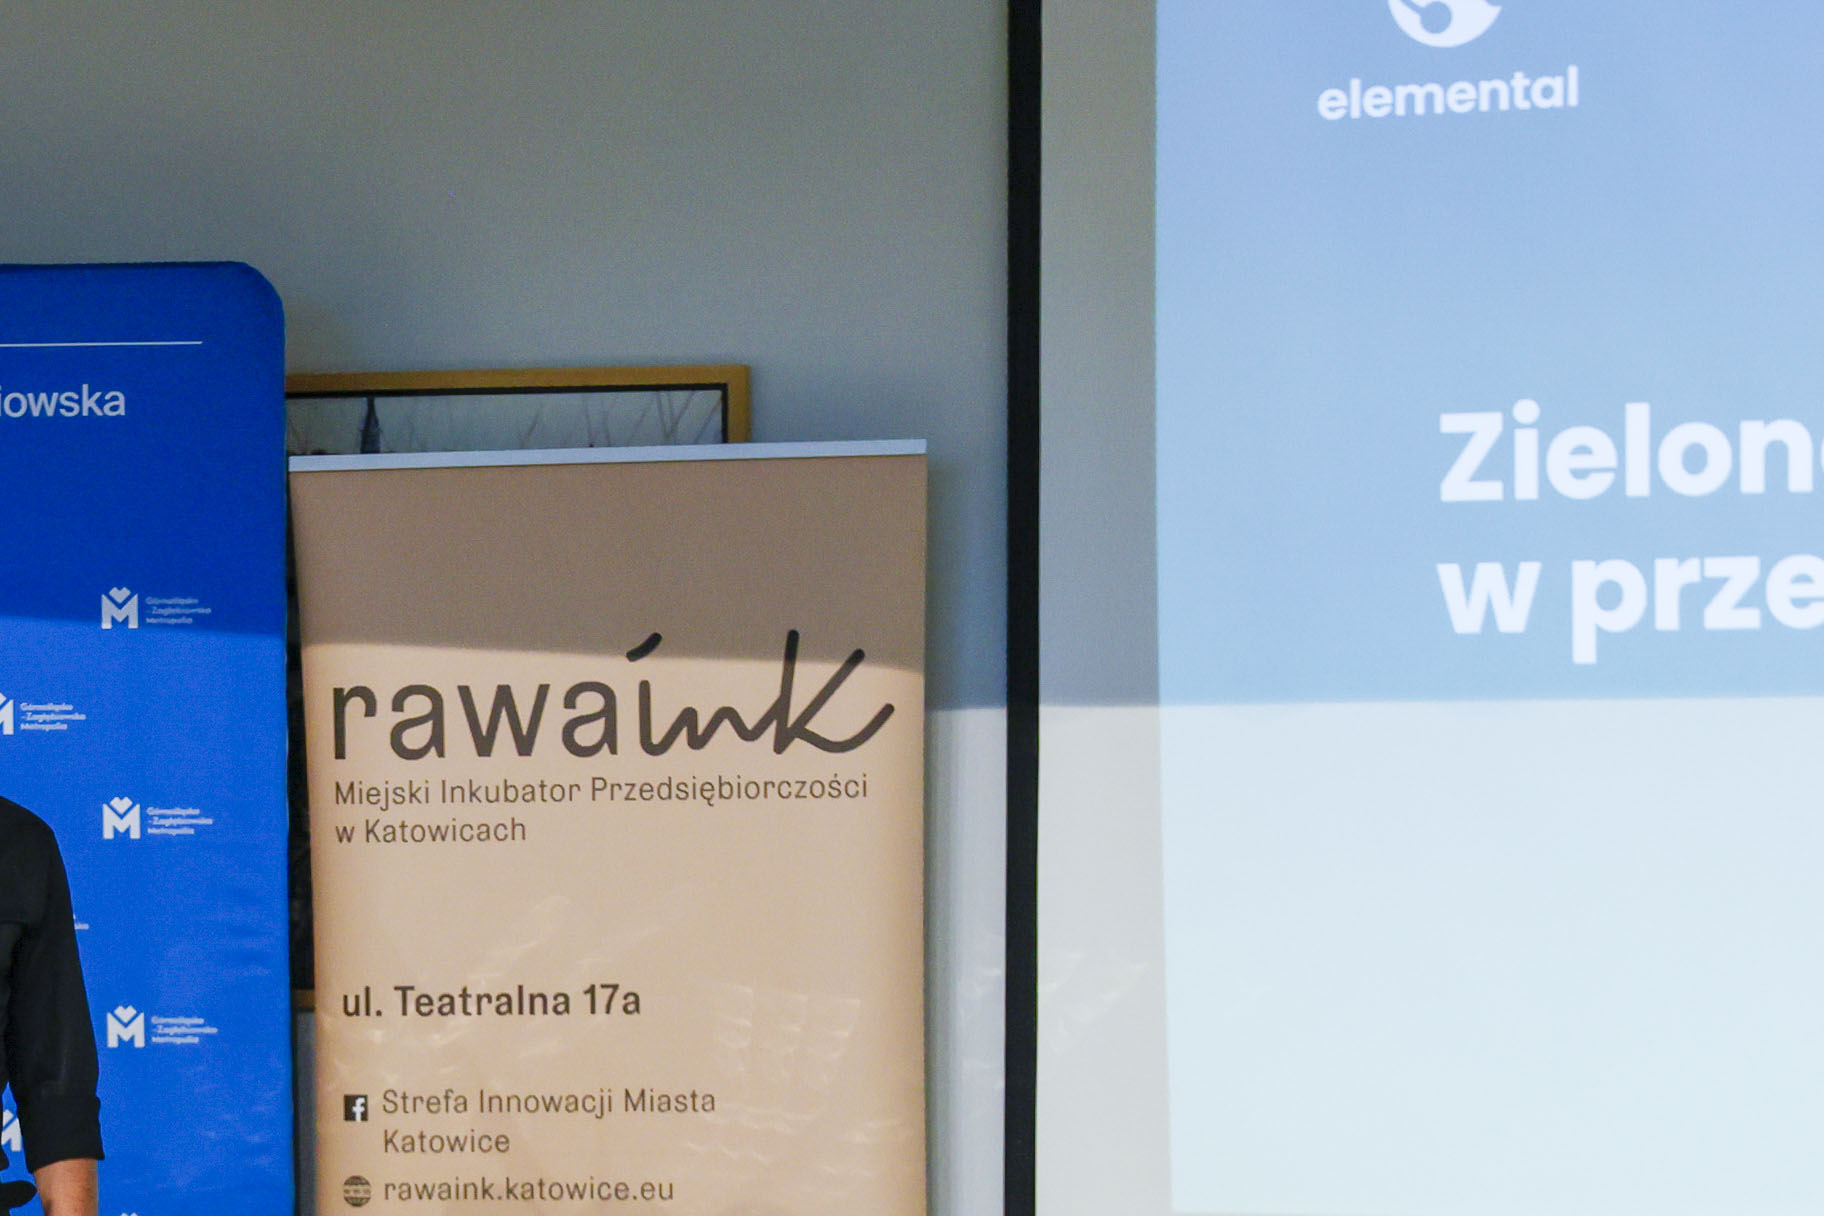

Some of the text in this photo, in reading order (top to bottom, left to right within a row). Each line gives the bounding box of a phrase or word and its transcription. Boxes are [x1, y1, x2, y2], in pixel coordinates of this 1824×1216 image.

[1318, 65, 1578, 120] elemental
[1439, 399, 1824, 502] Zielon
[1437, 561, 1542, 634] w
[334, 773, 868, 812] Miejski Inkubator Przedsiębiorczości
[335, 817, 526, 844] w Katowicach
[342, 983, 641, 1018] ul. Teatralna 17a
[382, 1087, 715, 1118] Strefa Innowacji Miasta
[383, 1128, 510, 1154] Katowice
[384, 1176, 674, 1202] rawaink.katowice.eu
